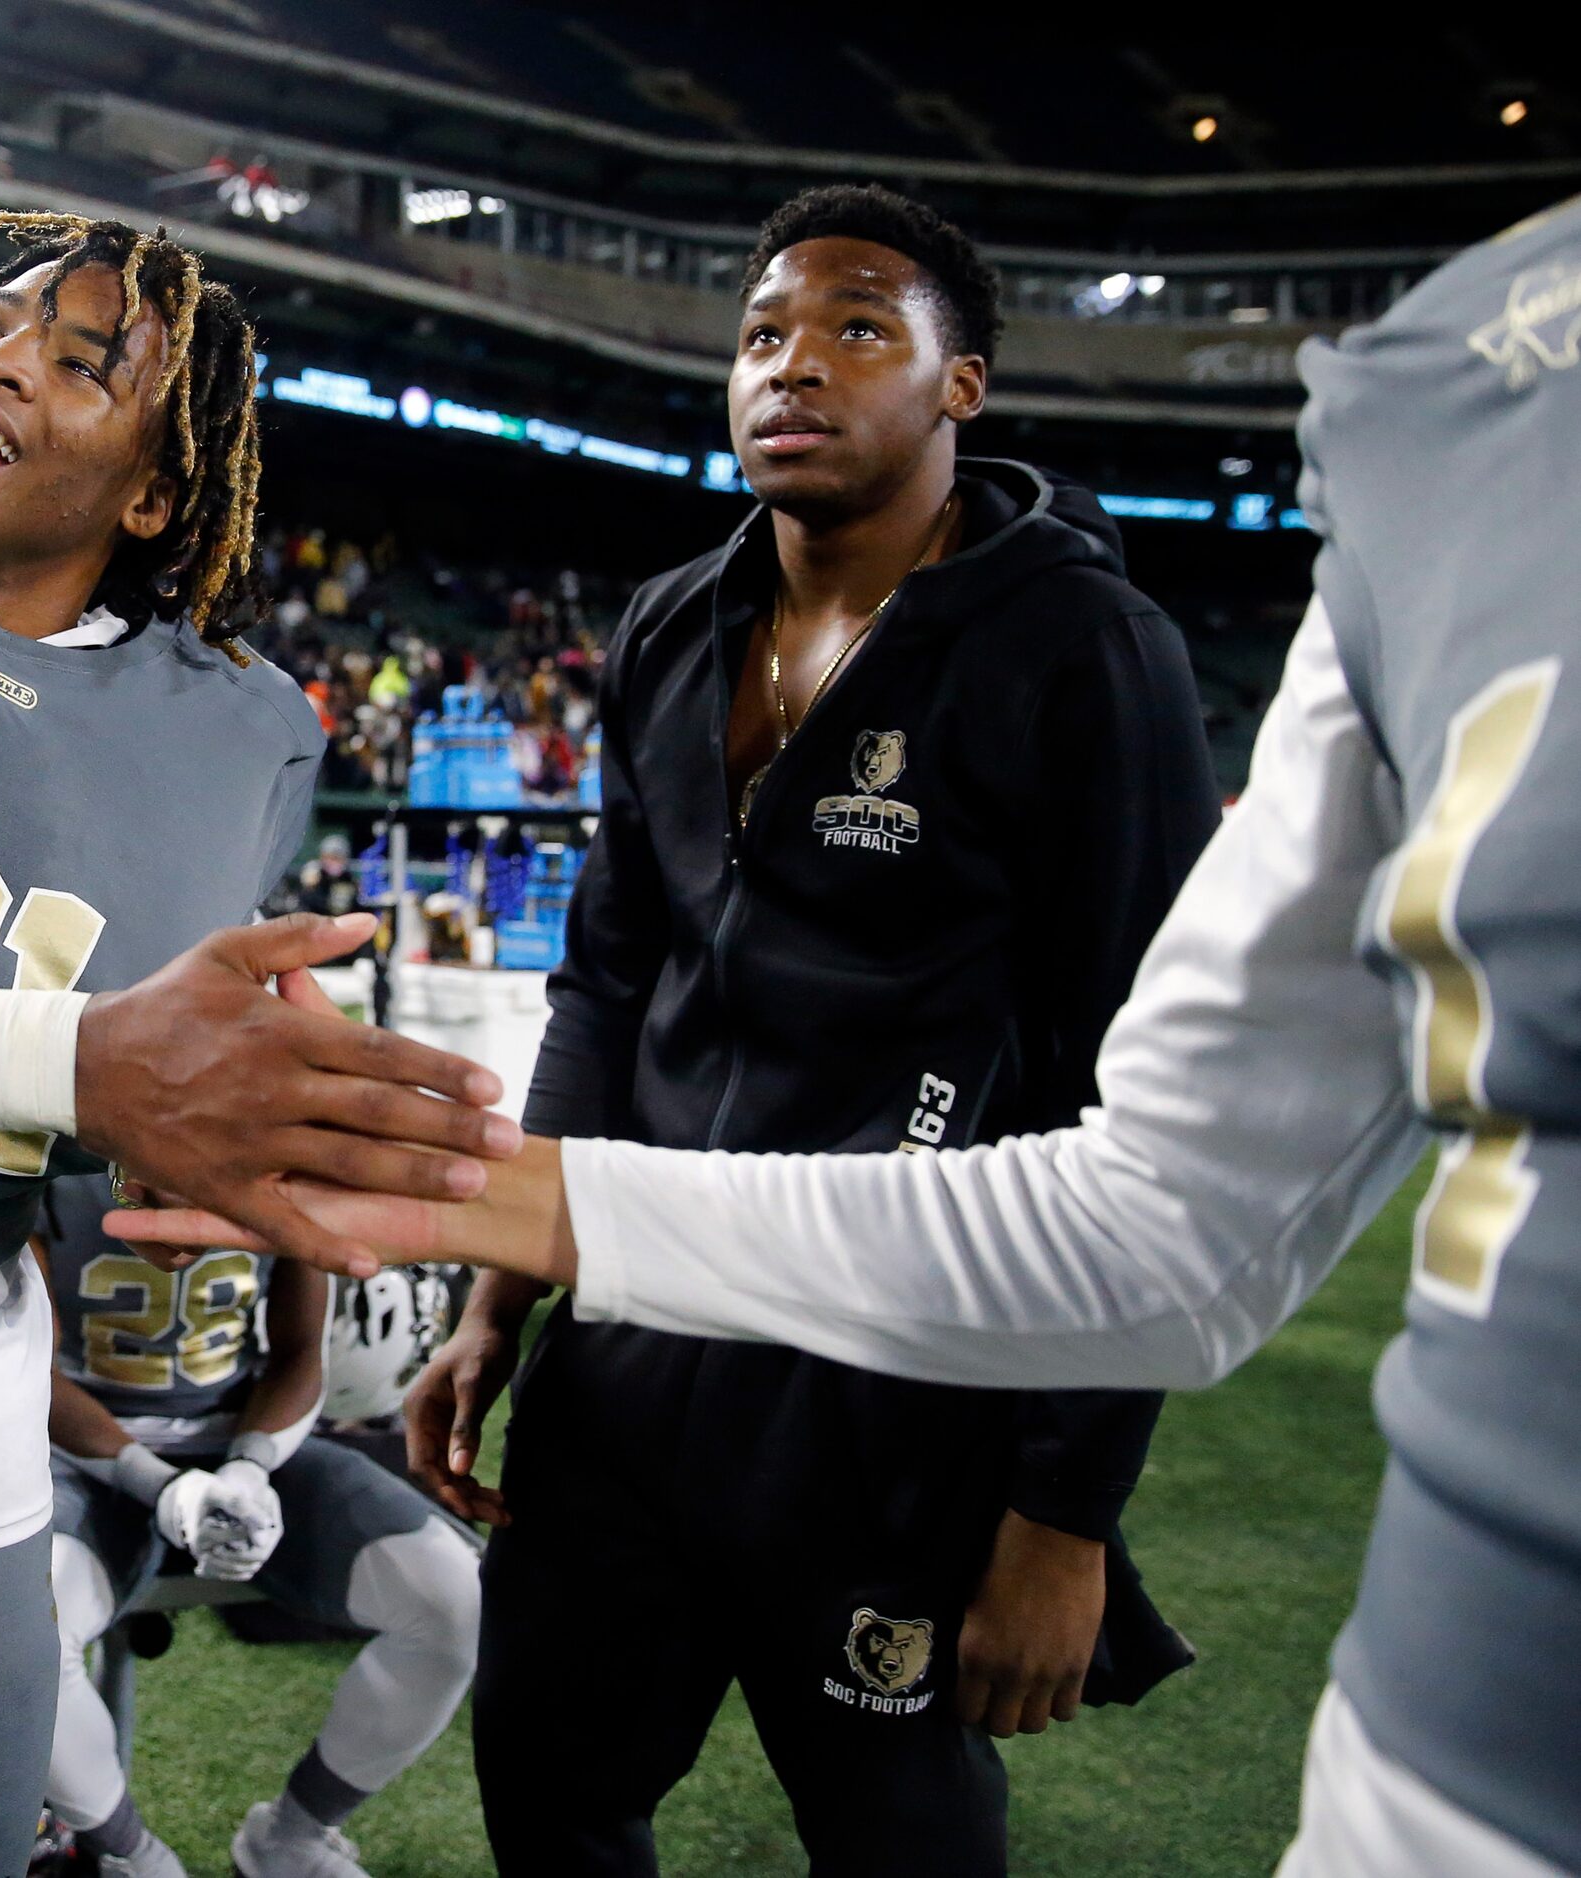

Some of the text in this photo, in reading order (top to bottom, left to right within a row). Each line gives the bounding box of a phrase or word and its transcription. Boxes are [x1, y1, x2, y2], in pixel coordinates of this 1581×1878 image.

[812, 794, 920, 844] SOC
[823, 830, 902, 855] FOOTBALL
[78, 1249, 260, 1391] 28
[823, 1676, 856, 1706] SOC
